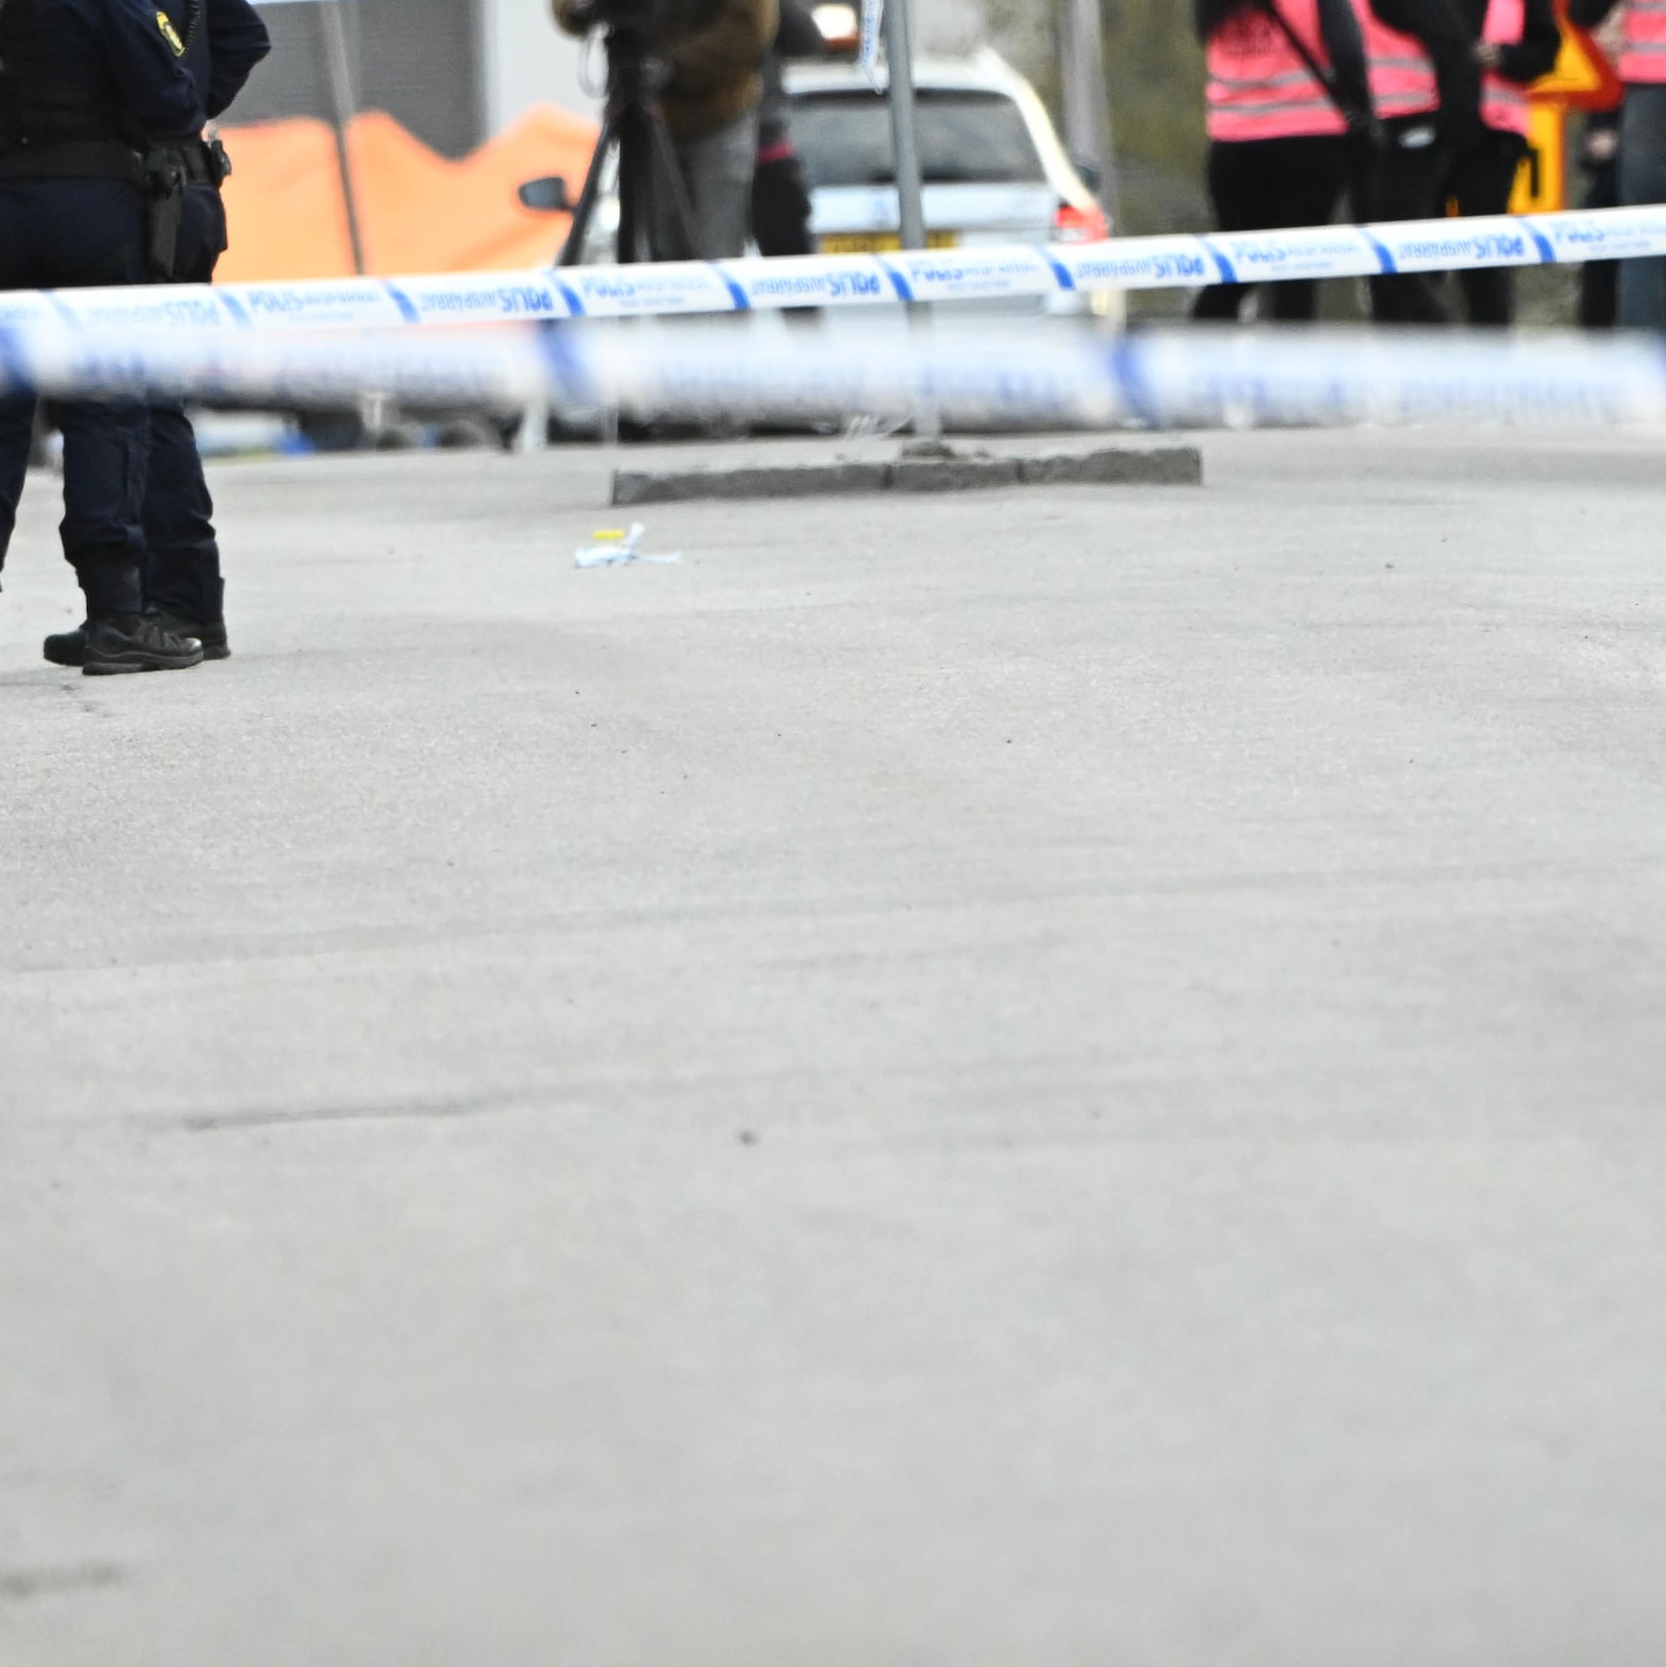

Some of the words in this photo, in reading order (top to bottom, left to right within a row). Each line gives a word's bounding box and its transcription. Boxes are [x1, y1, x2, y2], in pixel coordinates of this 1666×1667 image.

[1473, 233, 1525, 259] POLIS
[1154, 251, 1206, 280] POLIS
[829, 270, 881, 297] POLIS
[500, 285, 554, 313] POLIS
